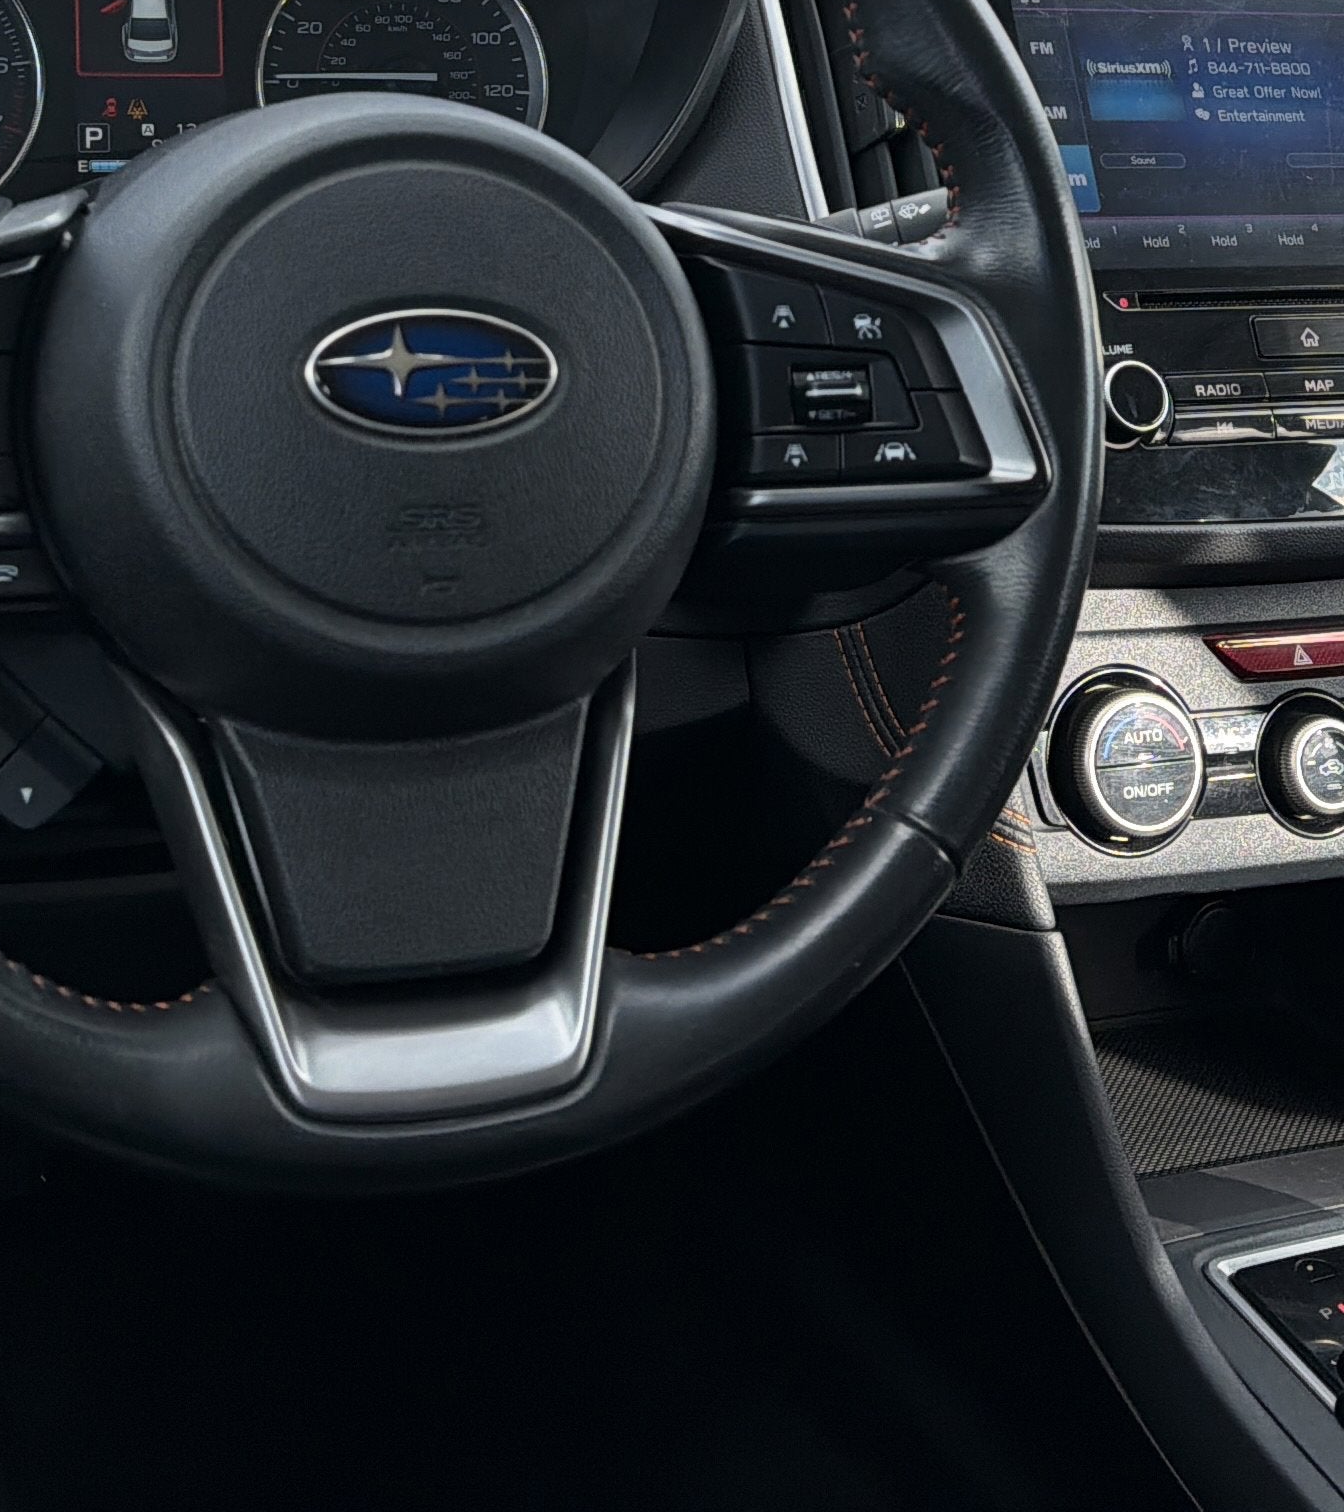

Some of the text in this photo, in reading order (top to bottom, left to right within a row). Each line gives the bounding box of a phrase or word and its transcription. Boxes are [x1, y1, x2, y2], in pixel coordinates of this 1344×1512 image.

[393, 14, 414, 24] 100
[296, 20, 323, 35] 20
[339, 37, 357, 47] 40
[470, 31, 502, 46] 100
[1030, 41, 1054, 56] FM
[1203, 38, 1211, 53] 1
[1229, 38, 1292, 54] Preview
[330, 56, 347, 66] 20
[1208, 61, 1311, 76] 844-711-8800
[483, 84, 514, 98] 120
[1213, 85, 1322, 99] Great Offer Now!
[1044, 106, 1068, 120] AM
[1217, 108, 1306, 123] Entertainment
[85, 127, 103, 149] P
[77, 160, 89, 173] E
[1130, 155, 1157, 166] Sound
[1177, 224, 1186, 234] 2
[1245, 223, 1254, 234] 3
[1311, 223, 1319, 233] 4
[1082, 235, 1101, 248] old
[1142, 235, 1170, 248] Hold
[1211, 234, 1238, 247] Hold
[1277, 233, 1304, 247] Hold
[1102, 343, 1134, 355] LUME
[1194, 382, 1242, 398] RADIO
[1304, 378, 1335, 392] MAP
[1123, 728, 1163, 744] AUTO
[1123, 781, 1175, 799] ON/OFF
[1319, 1307, 1333, 1320] P
